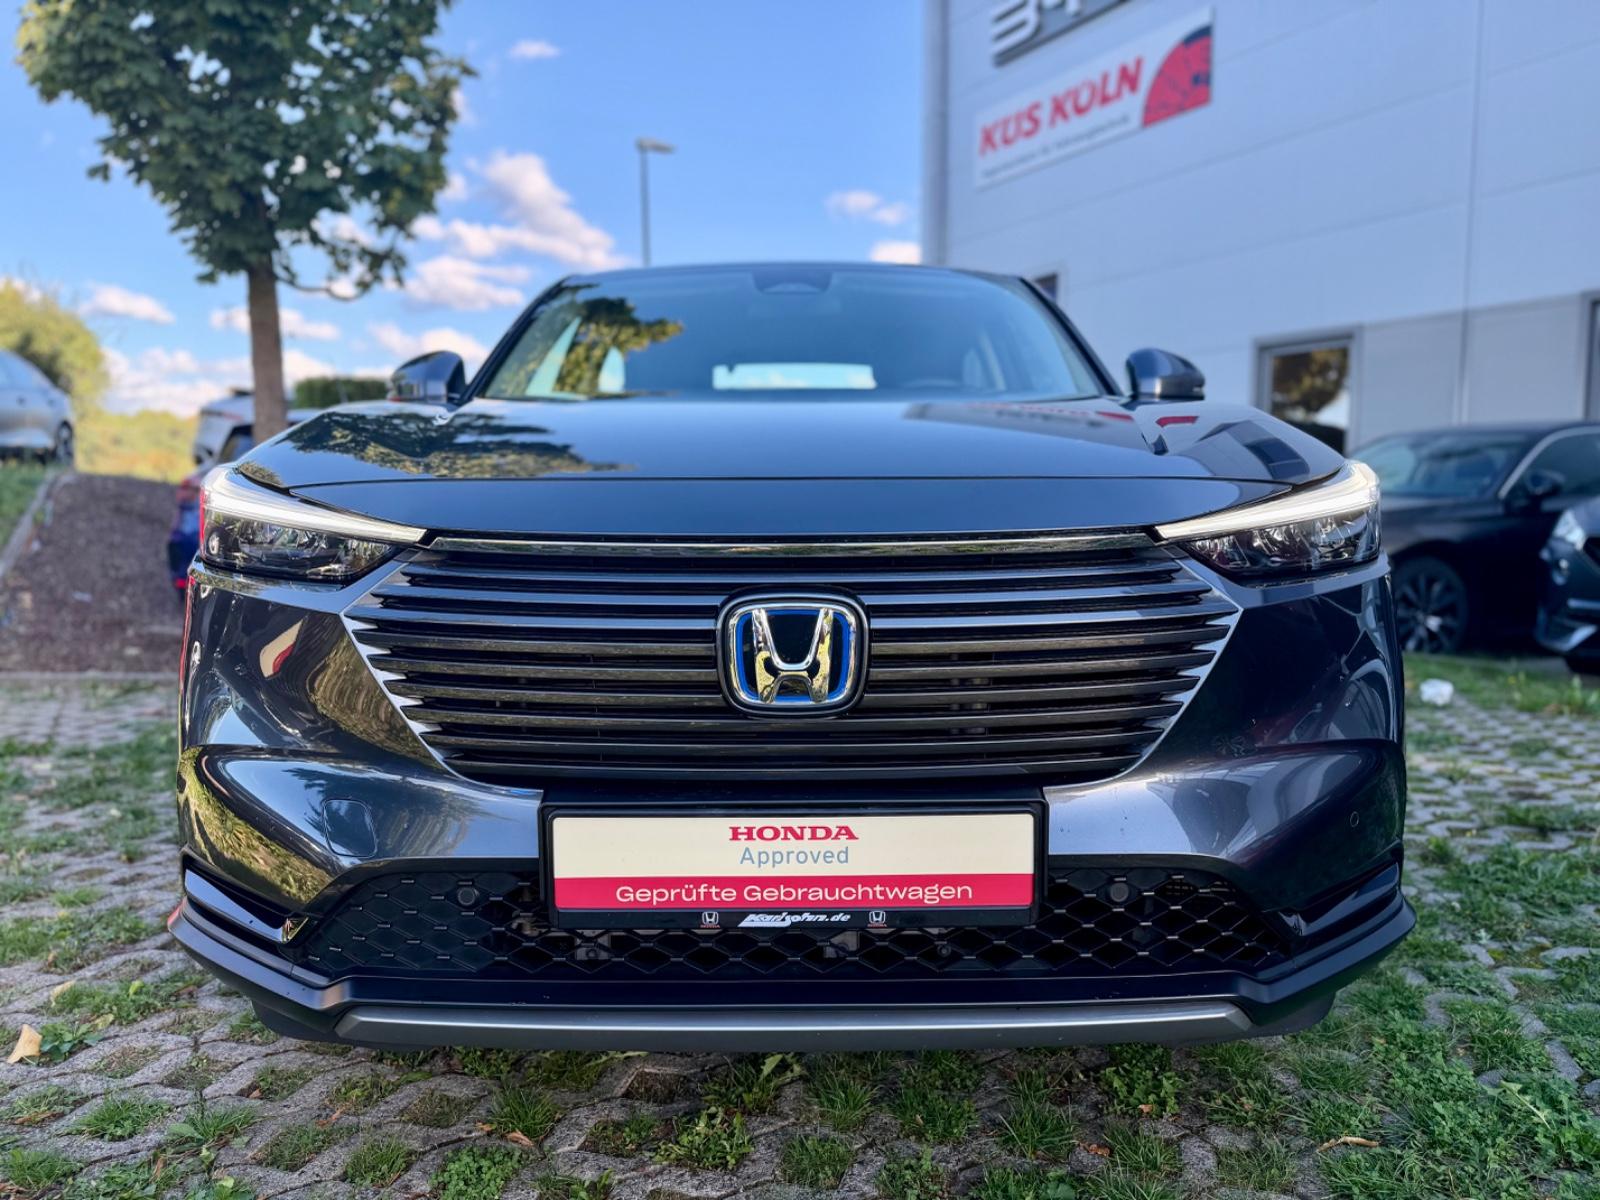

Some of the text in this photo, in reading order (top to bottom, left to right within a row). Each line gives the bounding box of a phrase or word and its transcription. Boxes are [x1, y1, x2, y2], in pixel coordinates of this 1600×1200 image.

[729, 825, 859, 841] HONDA
[740, 846, 849, 868] Approved
[616, 883, 973, 906] Geprüfte Gebrauchtwagen
